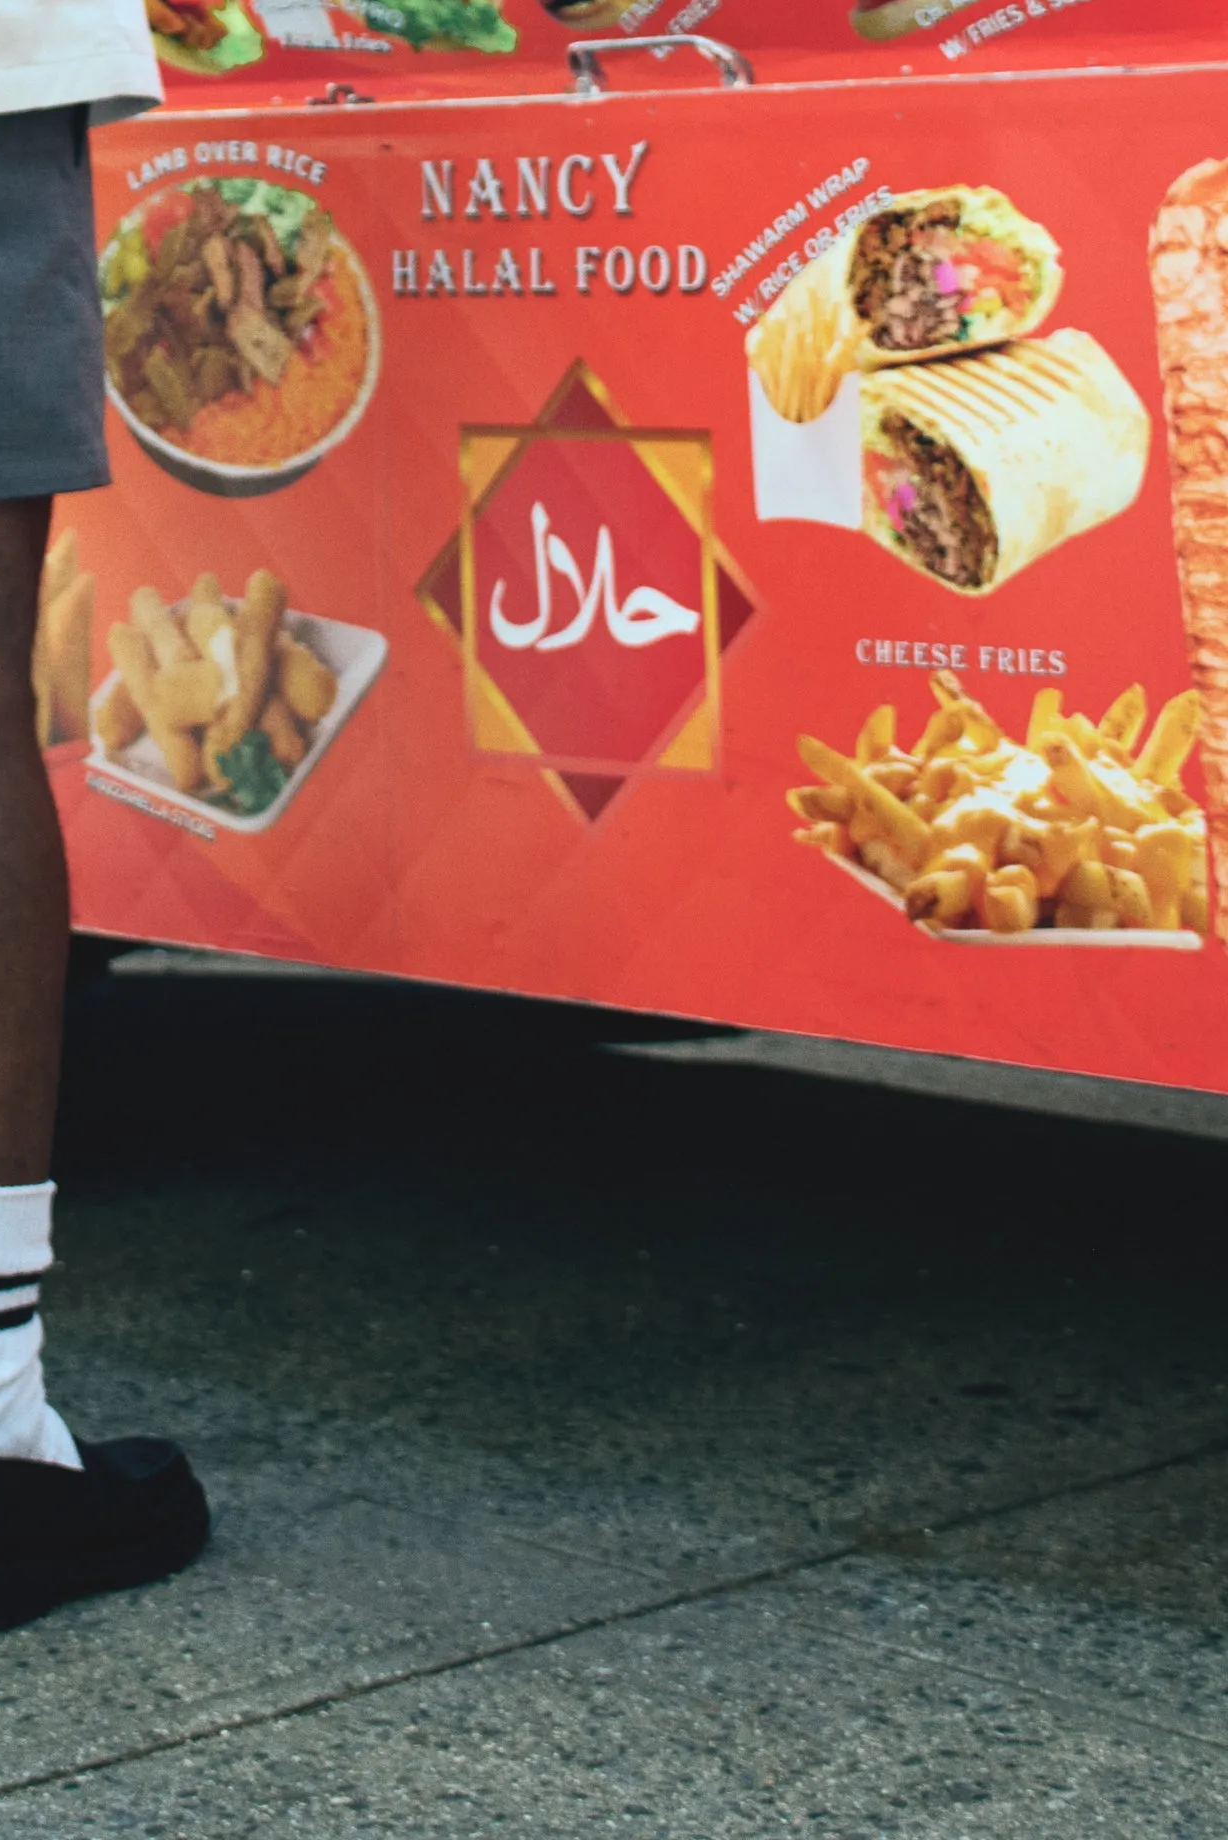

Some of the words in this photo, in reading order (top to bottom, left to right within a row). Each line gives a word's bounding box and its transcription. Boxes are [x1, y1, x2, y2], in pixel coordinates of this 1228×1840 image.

[126, 146, 189, 192] LAMB
[194, 139, 259, 166] OVER
[266, 144, 328, 186] RICE
[421, 139, 649, 220] NANCY
[710, 200, 810, 298] SHAWARM
[805, 156, 871, 210] WRAP
[803, 226, 836, 261] OR
[834, 184, 895, 237] FRIES
[391, 248, 557, 297] HALAL
[576, 243, 709, 295] FOOD
[489, 500, 702, 653] حلال
[855, 637, 969, 671] CHEESE
[978, 645, 1068, 677] FRIES
